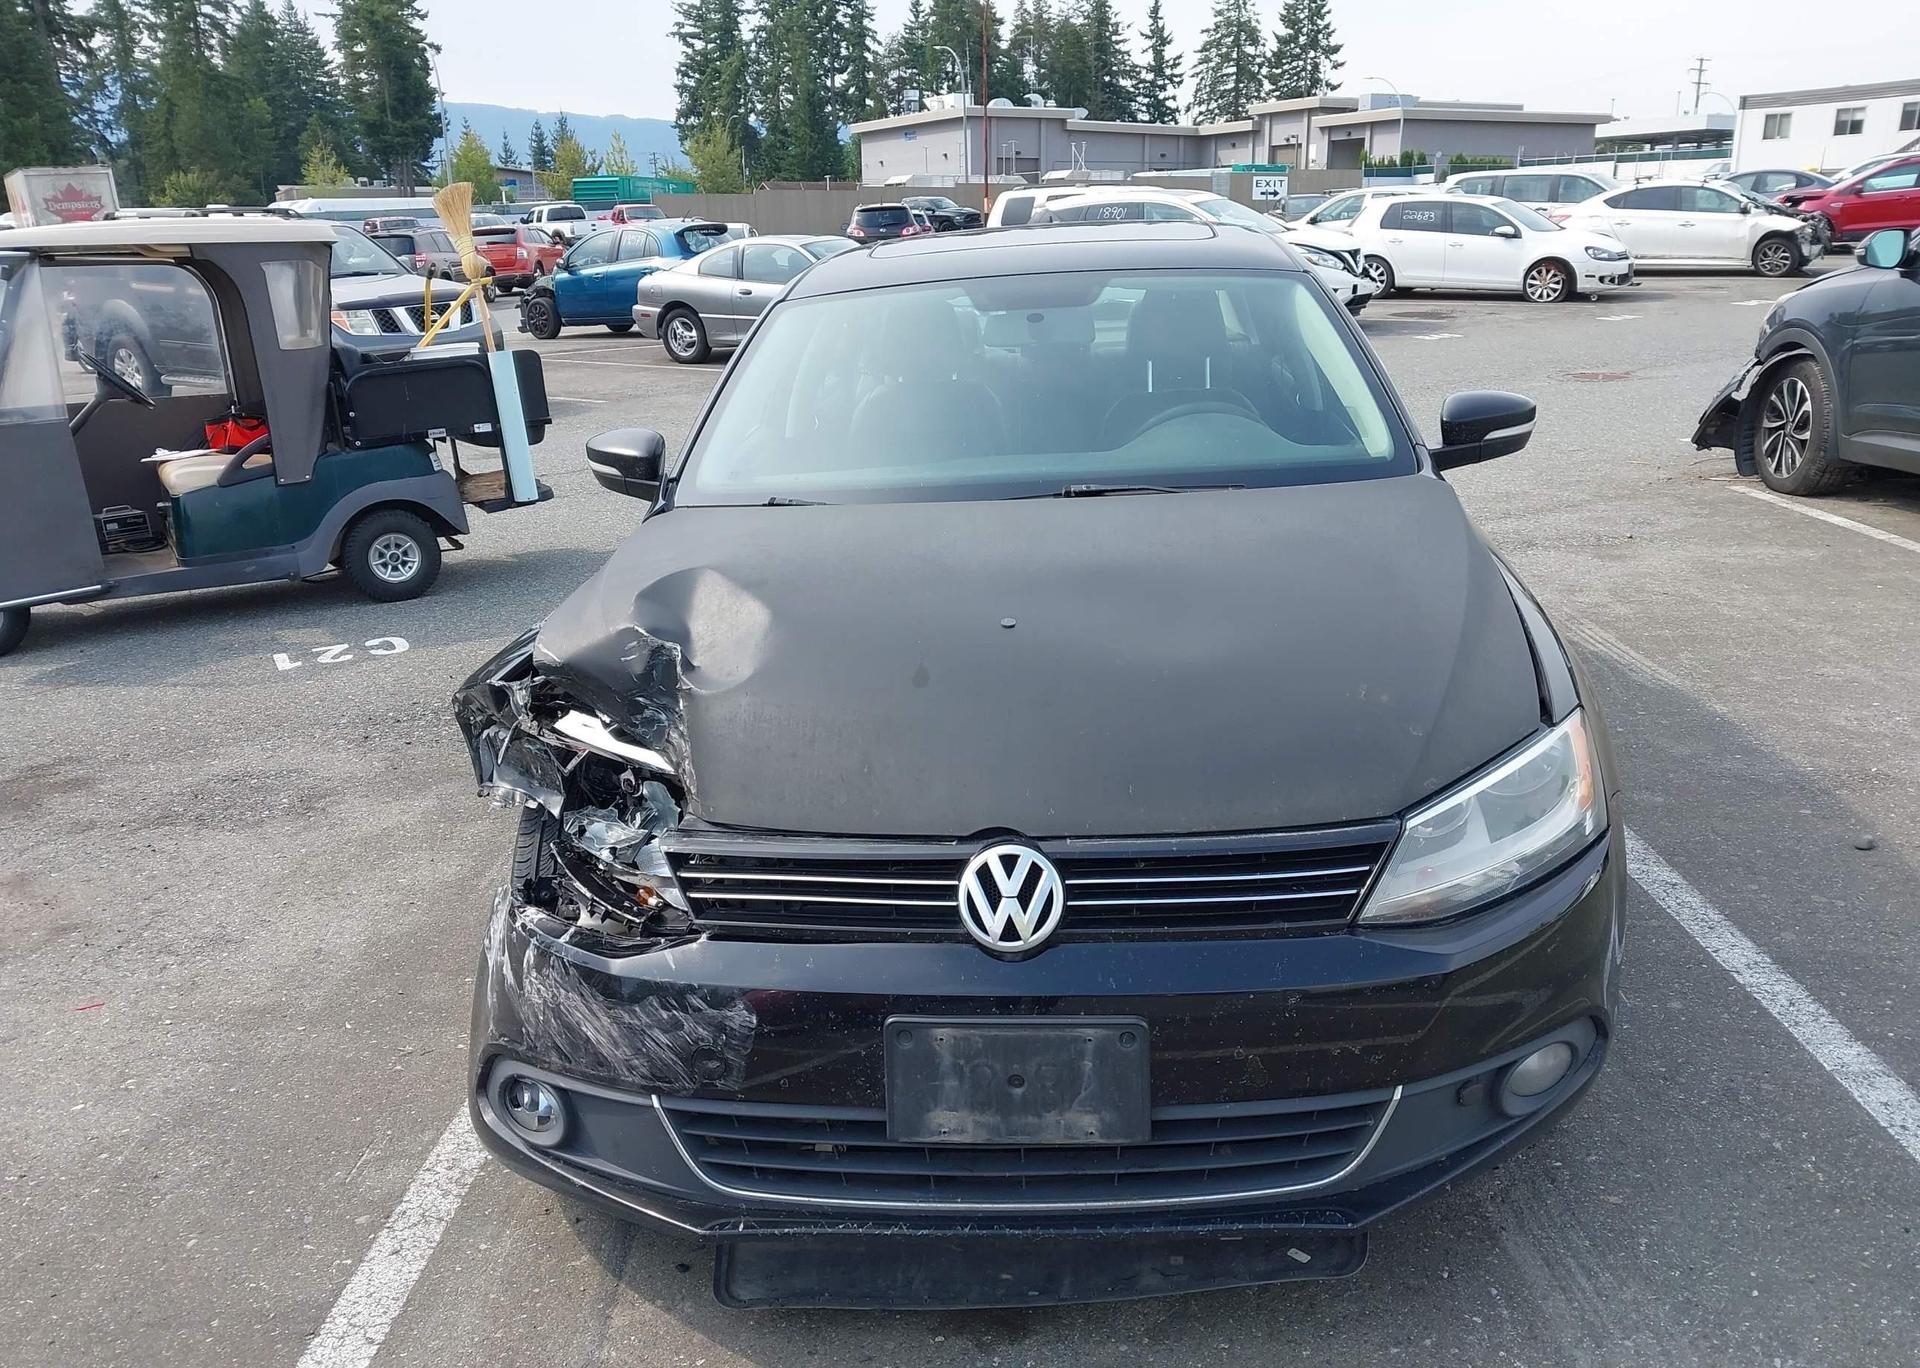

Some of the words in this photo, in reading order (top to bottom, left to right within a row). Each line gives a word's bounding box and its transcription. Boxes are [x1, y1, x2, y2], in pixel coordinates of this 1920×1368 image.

[1255, 179, 1286, 188] EXIT
[1097, 206, 1128, 220] 18901
[1403, 209, 1436, 222] 22683
[272, 636, 410, 672] C21
